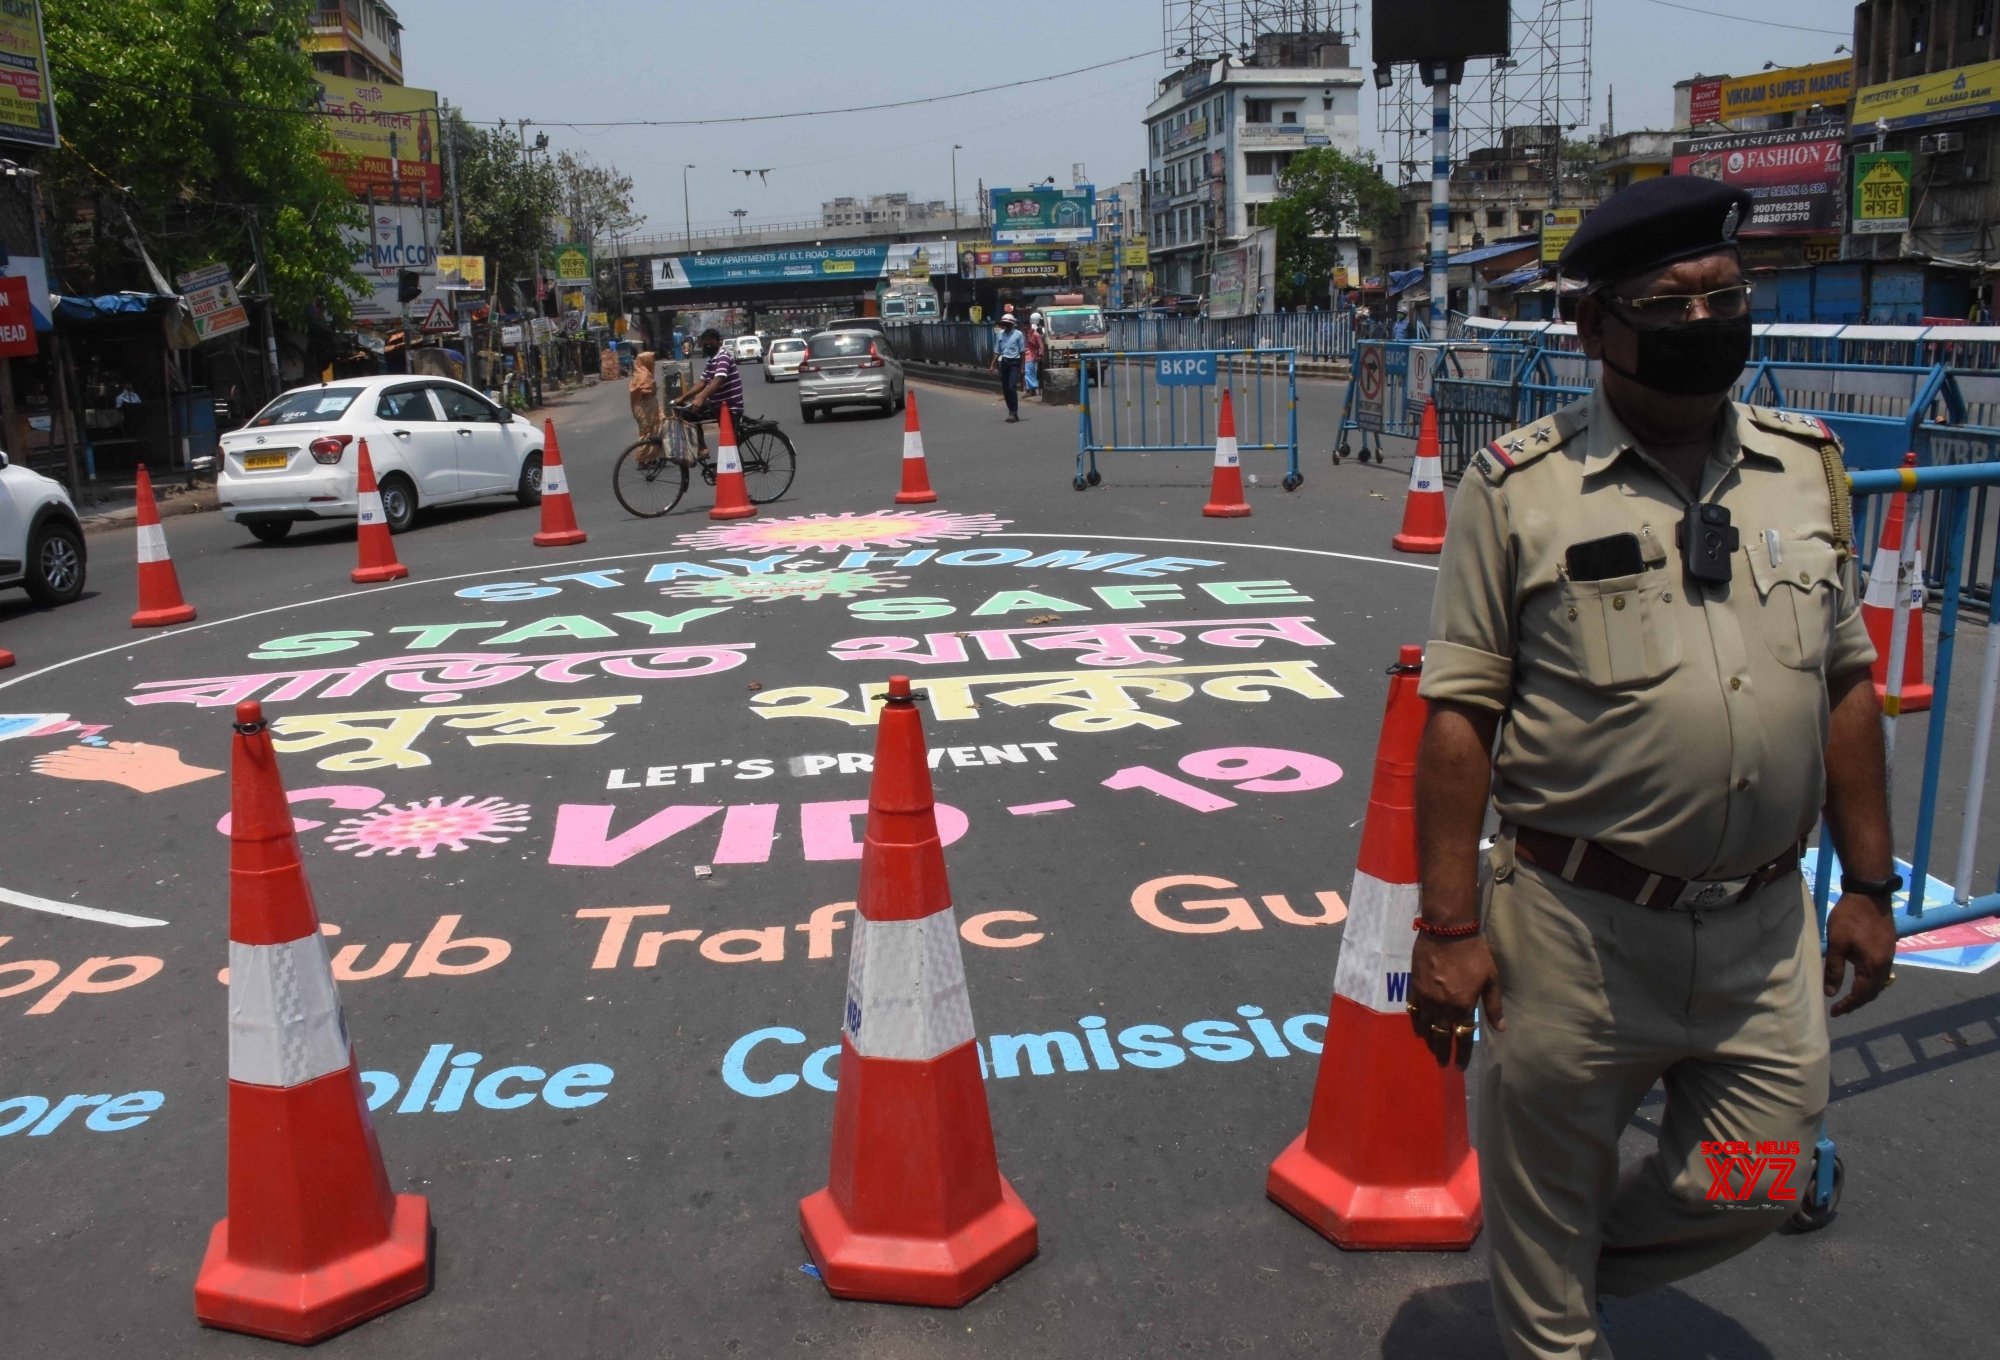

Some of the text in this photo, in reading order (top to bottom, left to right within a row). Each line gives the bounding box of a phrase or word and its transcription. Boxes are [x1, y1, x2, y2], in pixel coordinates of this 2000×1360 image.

[1727, 85, 1766, 106] VIKRAM
[1769, 79, 1806, 99] SUPER
[1808, 71, 1850, 94] MARKE
[1926, 86, 1992, 106] ALLAHABAD BANK
[1690, 127, 1845, 153] BIKRAM SUPER MERK
[1747, 145, 1820, 169] FASHION
[364, 160, 390, 175] PAUL
[1770, 184, 1800, 198] SALON
[1810, 182, 1828, 195] SPA
[694, 256, 721, 267] READY
[722, 253, 776, 265] APARTMENTS
[778, 251, 789, 262] AT
[789, 250, 804, 261] B.T.
[805, 250, 829, 260] ROAD
[835, 247, 876, 259] SODEPUR
[193, 301, 217, 315] HURT
[1161, 359, 1207, 376] BKPC
[1385, 350, 1406, 366] BKPC
[281, 411, 307, 419] UBER
[726, 462, 736, 470] WBP
[548, 483, 559, 491] WBP
[1417, 480, 1430, 489] WBP
[361, 512, 373, 522] WBP
[454, 554, 799, 602] STAY
[839, 548, 1225, 577] HOME
[248, 579, 1315, 661] STAY SAFE
[125, 616, 1336, 708] বাড়িতে থাকুন
[270, 660, 1344, 773] সুস্থ থাকুন
[606, 742, 1059, 790] LET'S PRVENT
[1100, 746, 1343, 813] 19
[0, 936, 165, 1015] op
[575, 902, 1044, 970] Trafc
[358, 1043, 614, 1113] olice
